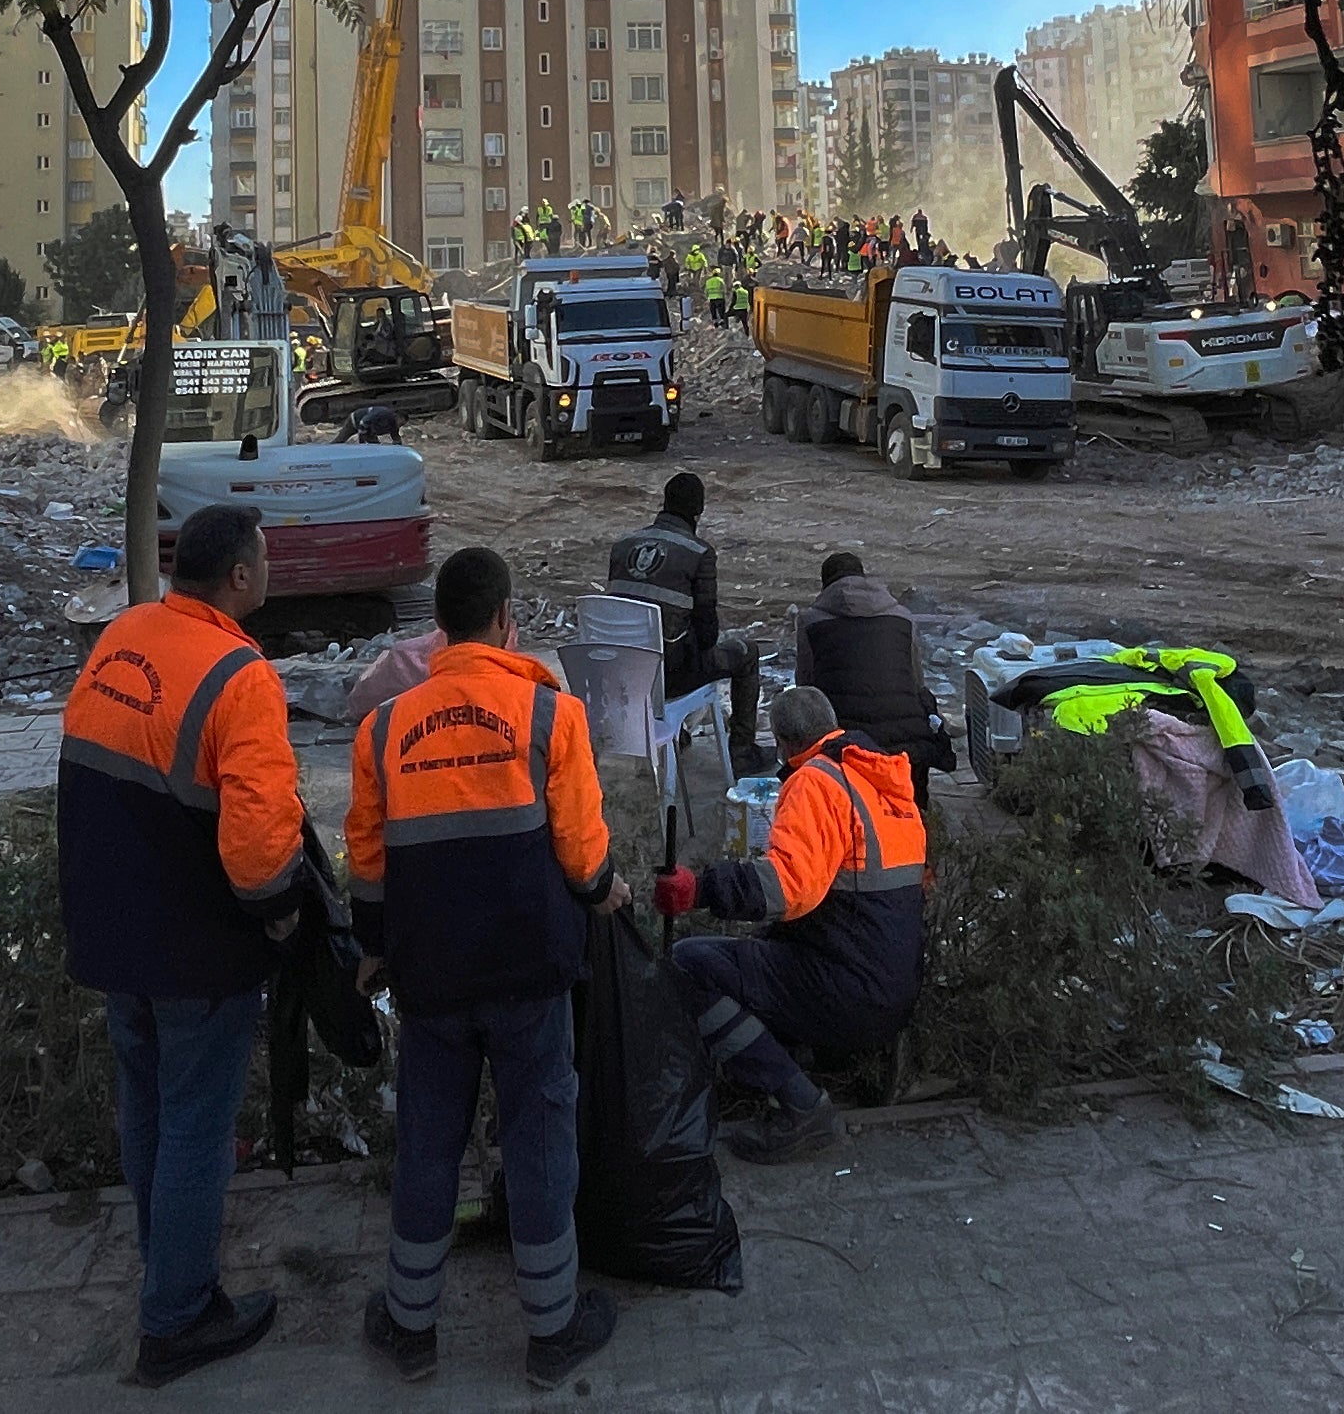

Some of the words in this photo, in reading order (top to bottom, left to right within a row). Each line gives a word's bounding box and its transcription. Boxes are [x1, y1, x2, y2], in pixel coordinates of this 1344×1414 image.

[956, 286, 1053, 303] BOLAT
[220, 348, 250, 359] CAN
[236, 376, 248, 385] 11
